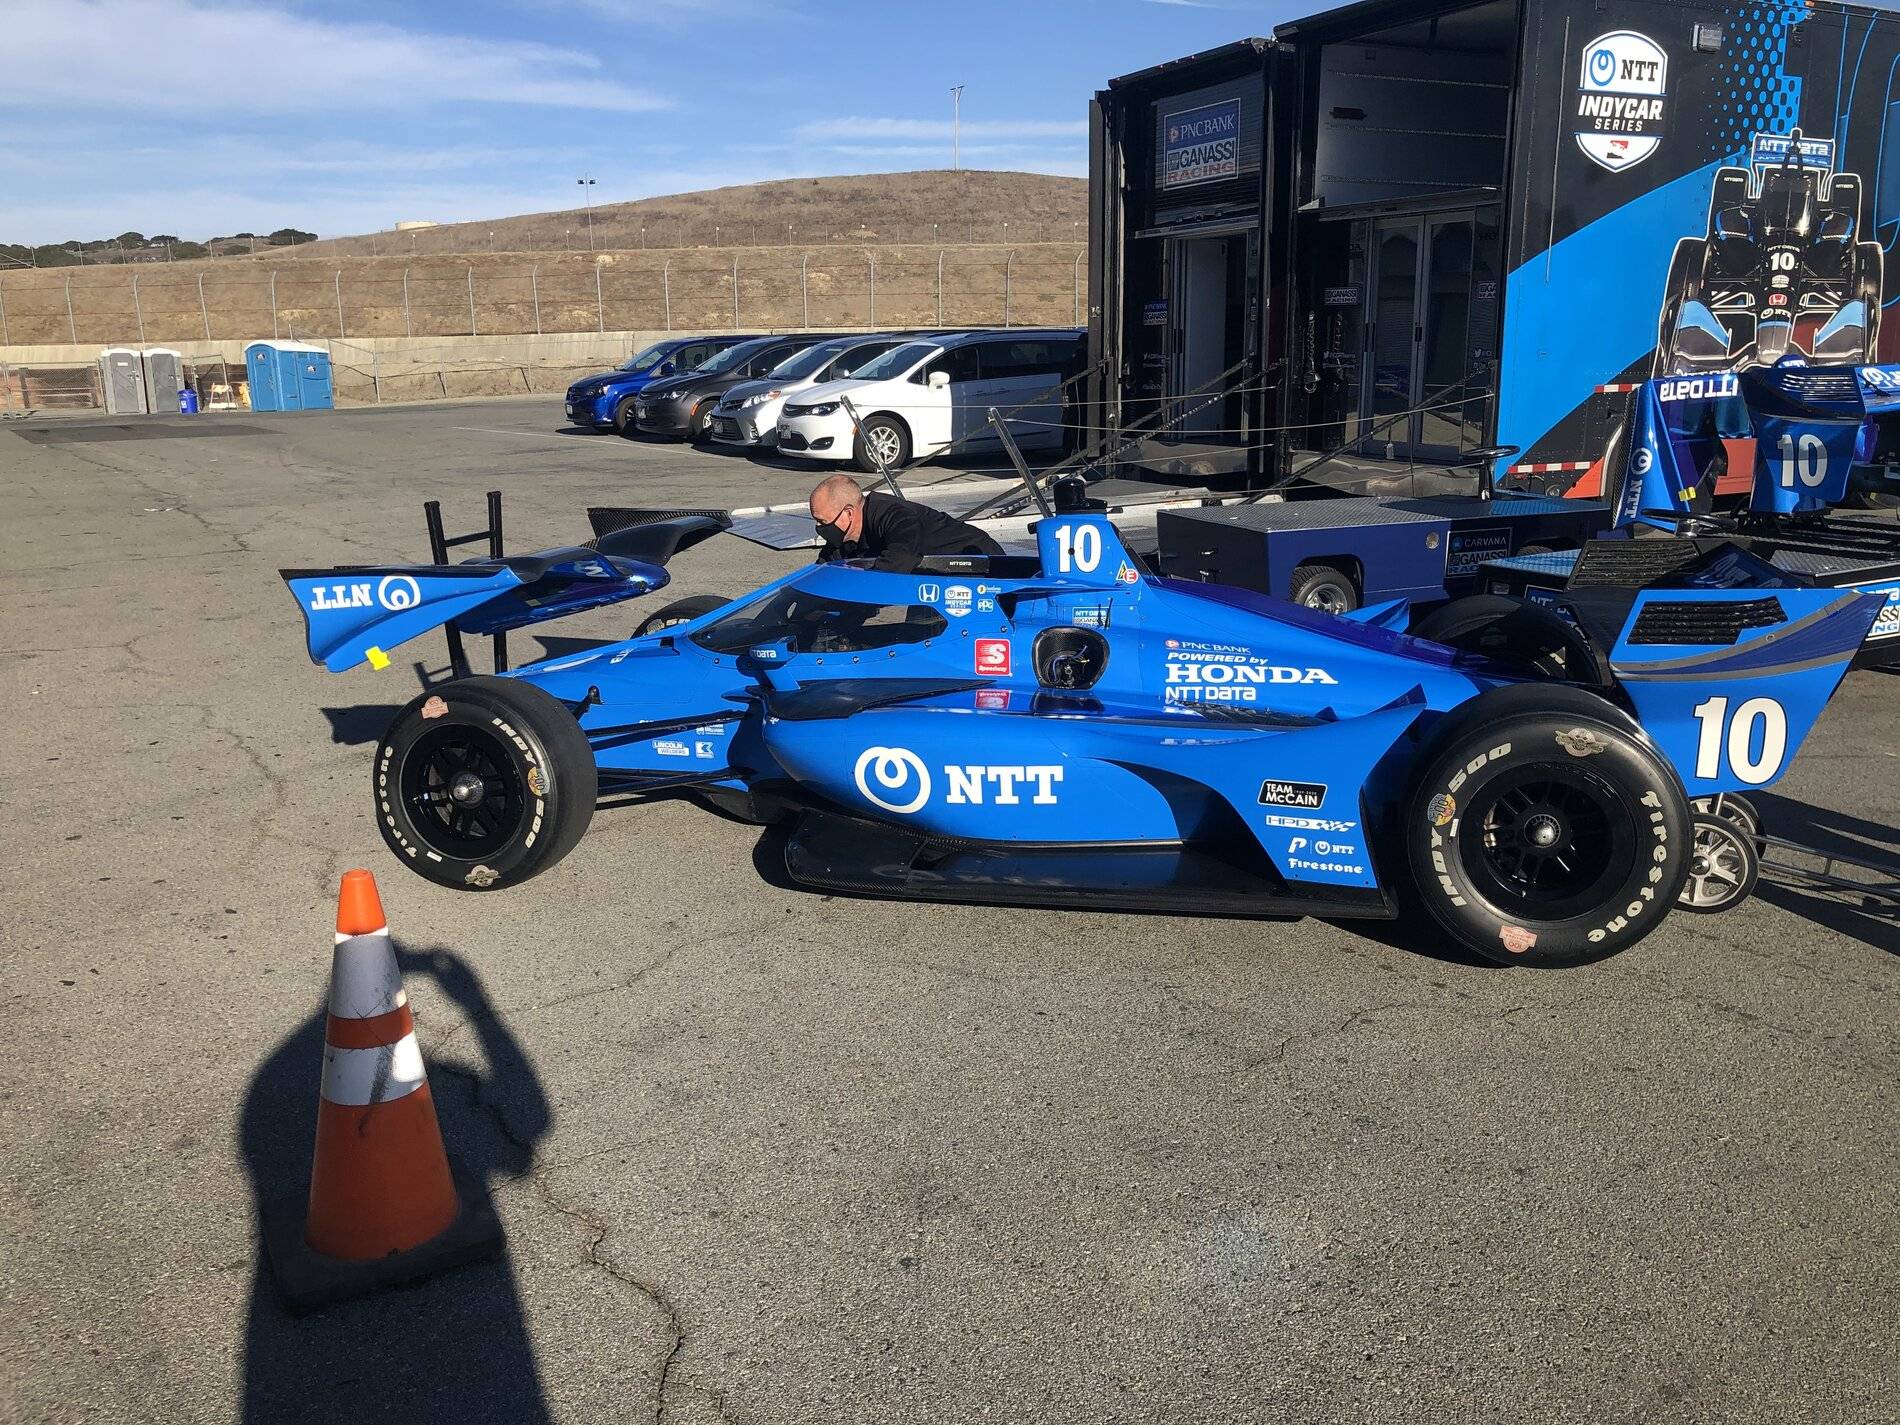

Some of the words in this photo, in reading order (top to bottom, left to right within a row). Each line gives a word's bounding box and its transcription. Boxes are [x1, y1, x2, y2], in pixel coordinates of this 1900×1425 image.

[1621, 59, 1658, 82] NTT
[1578, 95, 1664, 120] INDYCAR
[1594, 118, 1643, 132] SERIES
[1181, 141, 1235, 167] GANASSI
[1168, 162, 1235, 182] RACING
[1770, 252, 1796, 271] 10
[1777, 434, 1828, 487] 10
[1055, 524, 1103, 573] 10
[1464, 536, 1507, 548] CARVANA
[311, 583, 373, 610] NTT
[978, 665, 1008, 673] Speedway
[1167, 653, 1248, 663] POWERED
[1249, 656, 1268, 665] by
[1165, 663, 1339, 684] HONDA
[1165, 686, 1203, 701] NTT
[654, 741, 683, 749] LINCOLN
[1693, 696, 1788, 785] 10
[1448, 742, 1511, 793] 500
[492, 718, 537, 765] INDY
[525, 799, 545, 848] 500
[945, 765, 1064, 805] NTT
[1266, 783, 1293, 793] TEAM
[1265, 792, 1318, 806] McCAIN
[1268, 817, 1310, 828] HPD
[1332, 845, 1355, 855] NTT
[1288, 858, 1364, 874] Firestone
[1431, 827, 1467, 907] INDY
[1588, 791, 1668, 943] Firestone
